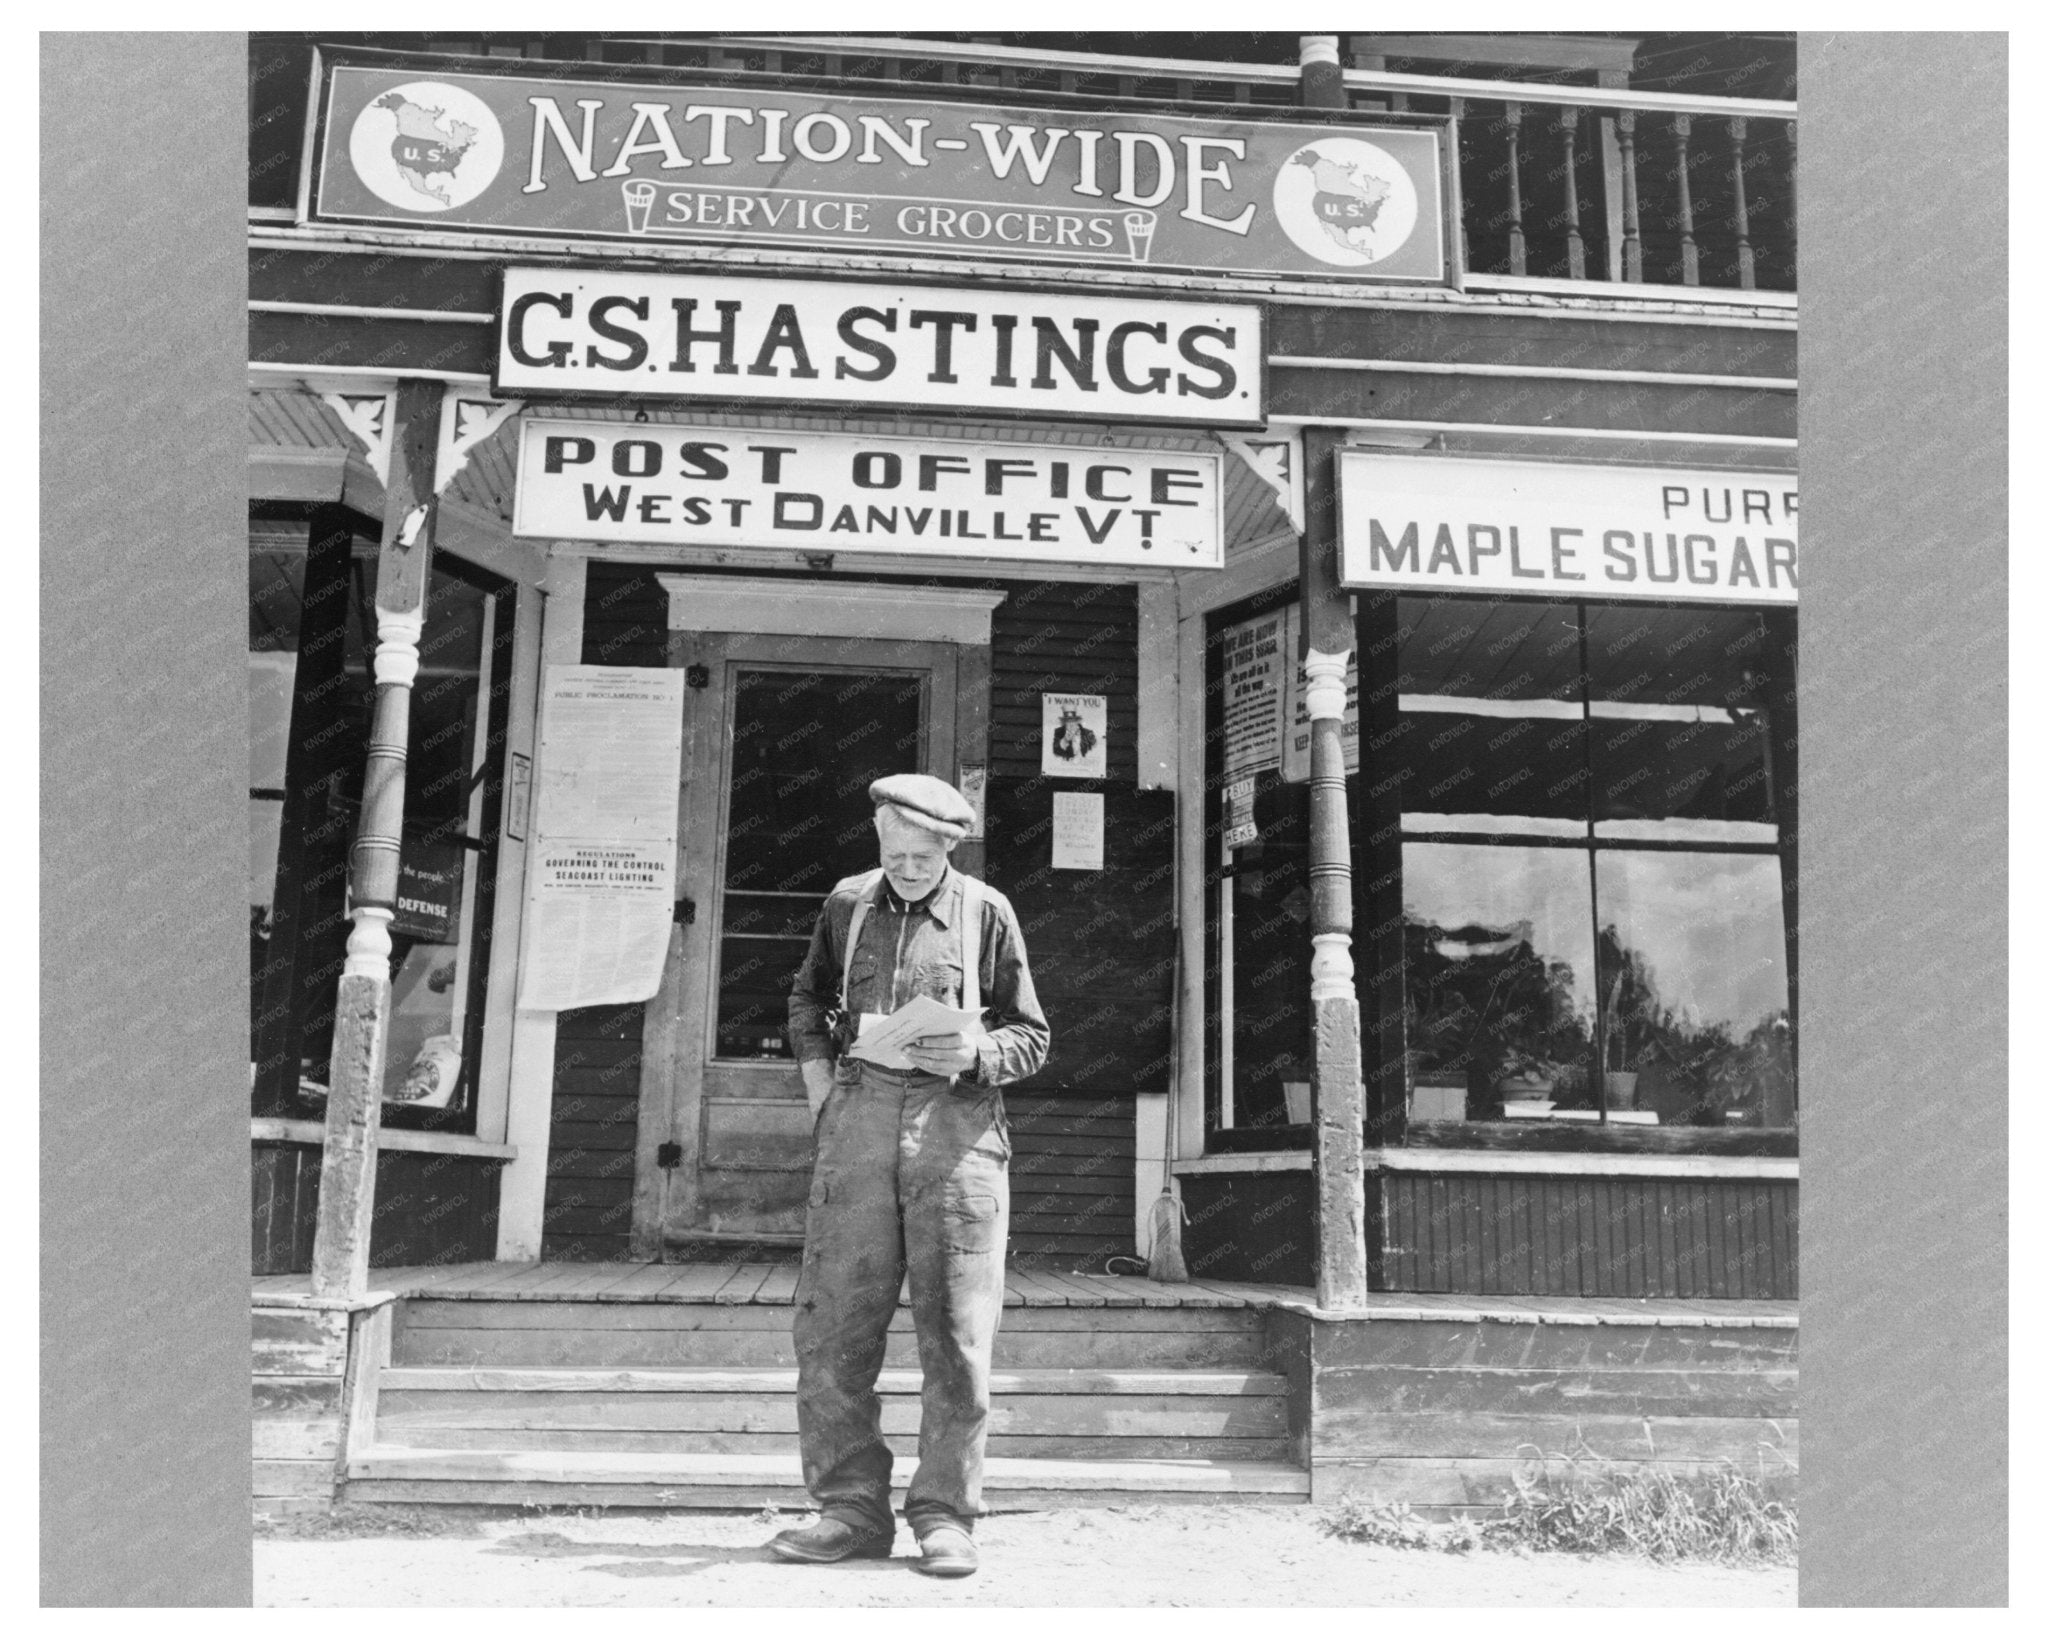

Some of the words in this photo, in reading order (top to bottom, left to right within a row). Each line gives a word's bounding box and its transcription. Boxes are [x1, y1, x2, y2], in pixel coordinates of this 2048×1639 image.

[522, 96, 1258, 237] NATION-WIDE
[666, 191, 870, 233] SERVICE
[897, 204, 1115, 247] GROCERS
[544, 436, 797, 486] POST
[852, 450, 1204, 507] OFFICE
[583, 483, 752, 528] WEST
[774, 492, 1060, 542] DANVILLE
[1369, 518, 1587, 581] MAPLE
[1603, 529, 1798, 589] SUGAR
[1238, 629, 1254, 649] ARE
[1234, 647, 1254, 668] THIS
[555, 691, 583, 699] PUBLIC
[586, 691, 649, 700] PROCLAMATION
[1054, 697, 1080, 705] WANT
[1082, 697, 1101, 707] YOU
[1233, 781, 1253, 798] BUY
[1225, 825, 1254, 845] HERE
[577, 850, 636, 859] REGULATIONS
[545, 859, 598, 869] GOVERNING
[602, 859, 619, 869] THE
[623, 861, 666, 872] CONTROL
[556, 871, 605, 881] SEACOAST
[609, 872, 654, 882] LIGHTING
[398, 896, 448, 918] DEFENSE
